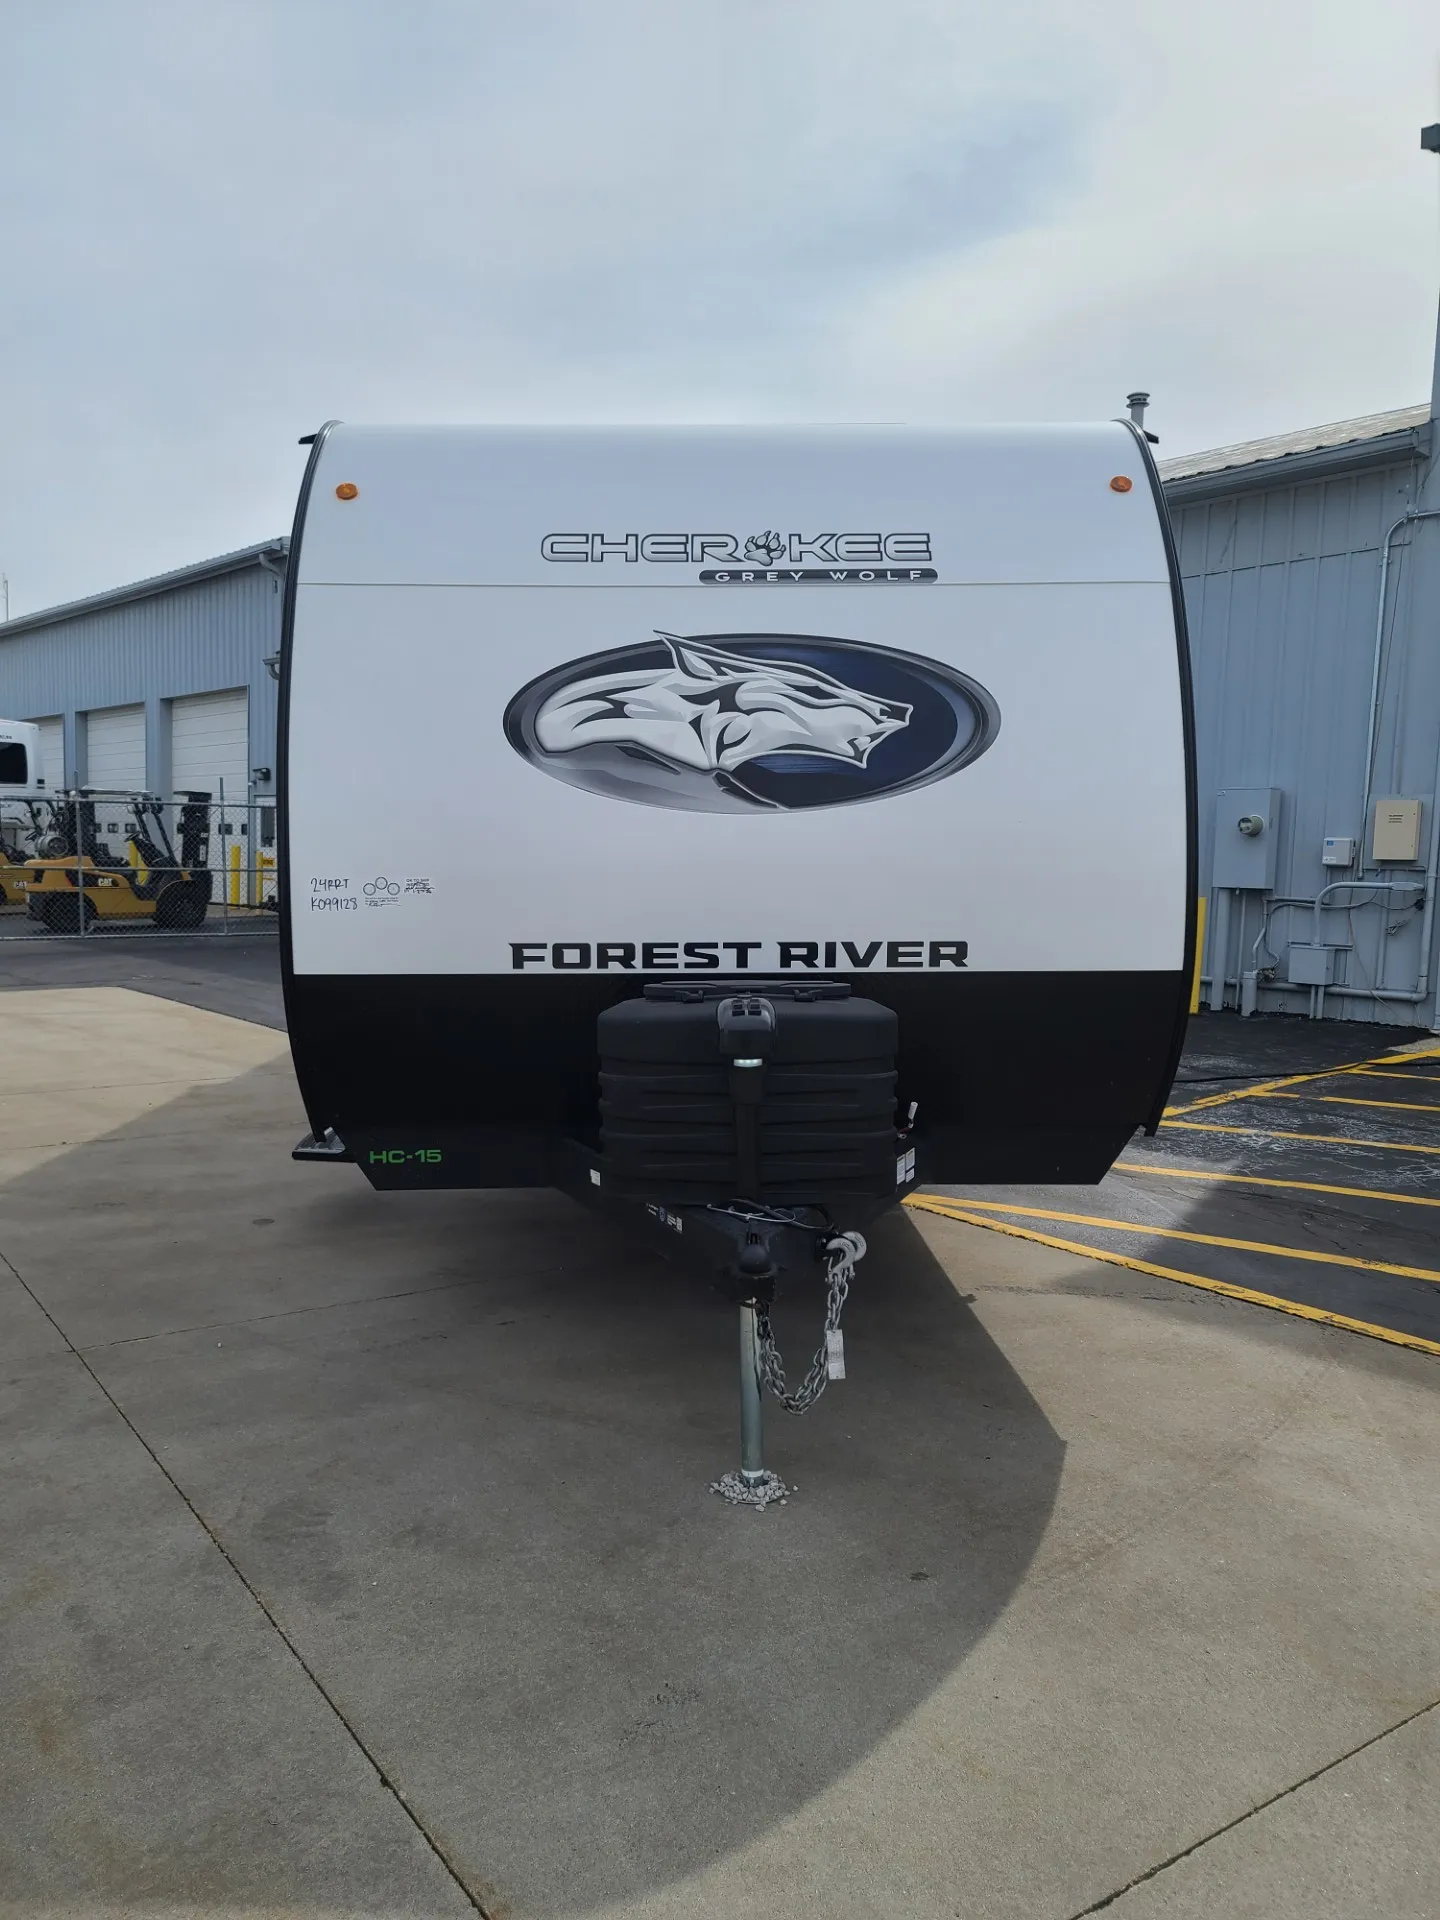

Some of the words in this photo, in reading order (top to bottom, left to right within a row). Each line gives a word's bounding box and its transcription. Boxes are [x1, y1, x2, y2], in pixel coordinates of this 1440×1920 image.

[715, 571, 804, 582] GREY
[829, 570, 922, 581] WOLF
[98, 878, 113, 887] CAT
[311, 896, 358, 911] K099128
[508, 942, 762, 970] FOREST
[776, 941, 969, 968] RIVER
[369, 1149, 443, 1164] HC-15
